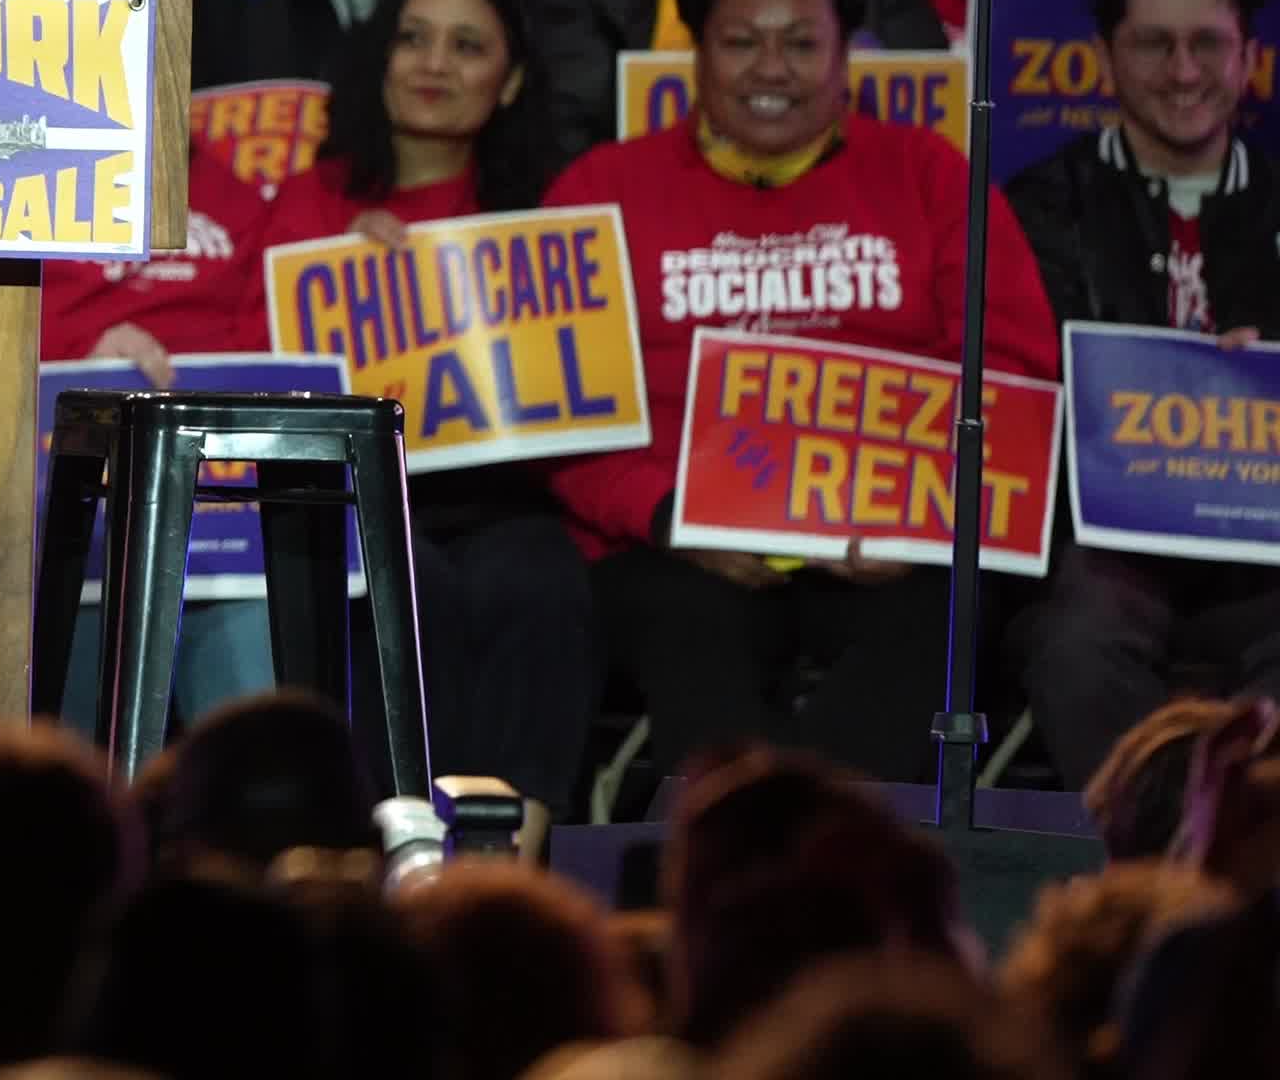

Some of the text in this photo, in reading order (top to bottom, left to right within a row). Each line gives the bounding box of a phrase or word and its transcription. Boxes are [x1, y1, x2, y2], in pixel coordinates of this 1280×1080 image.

[296, 227, 608, 372] CHILDCARE
[662, 261, 902, 322] SOCIALISTS
[420, 322, 618, 439] ALL
[788, 434, 1029, 539] RENT
